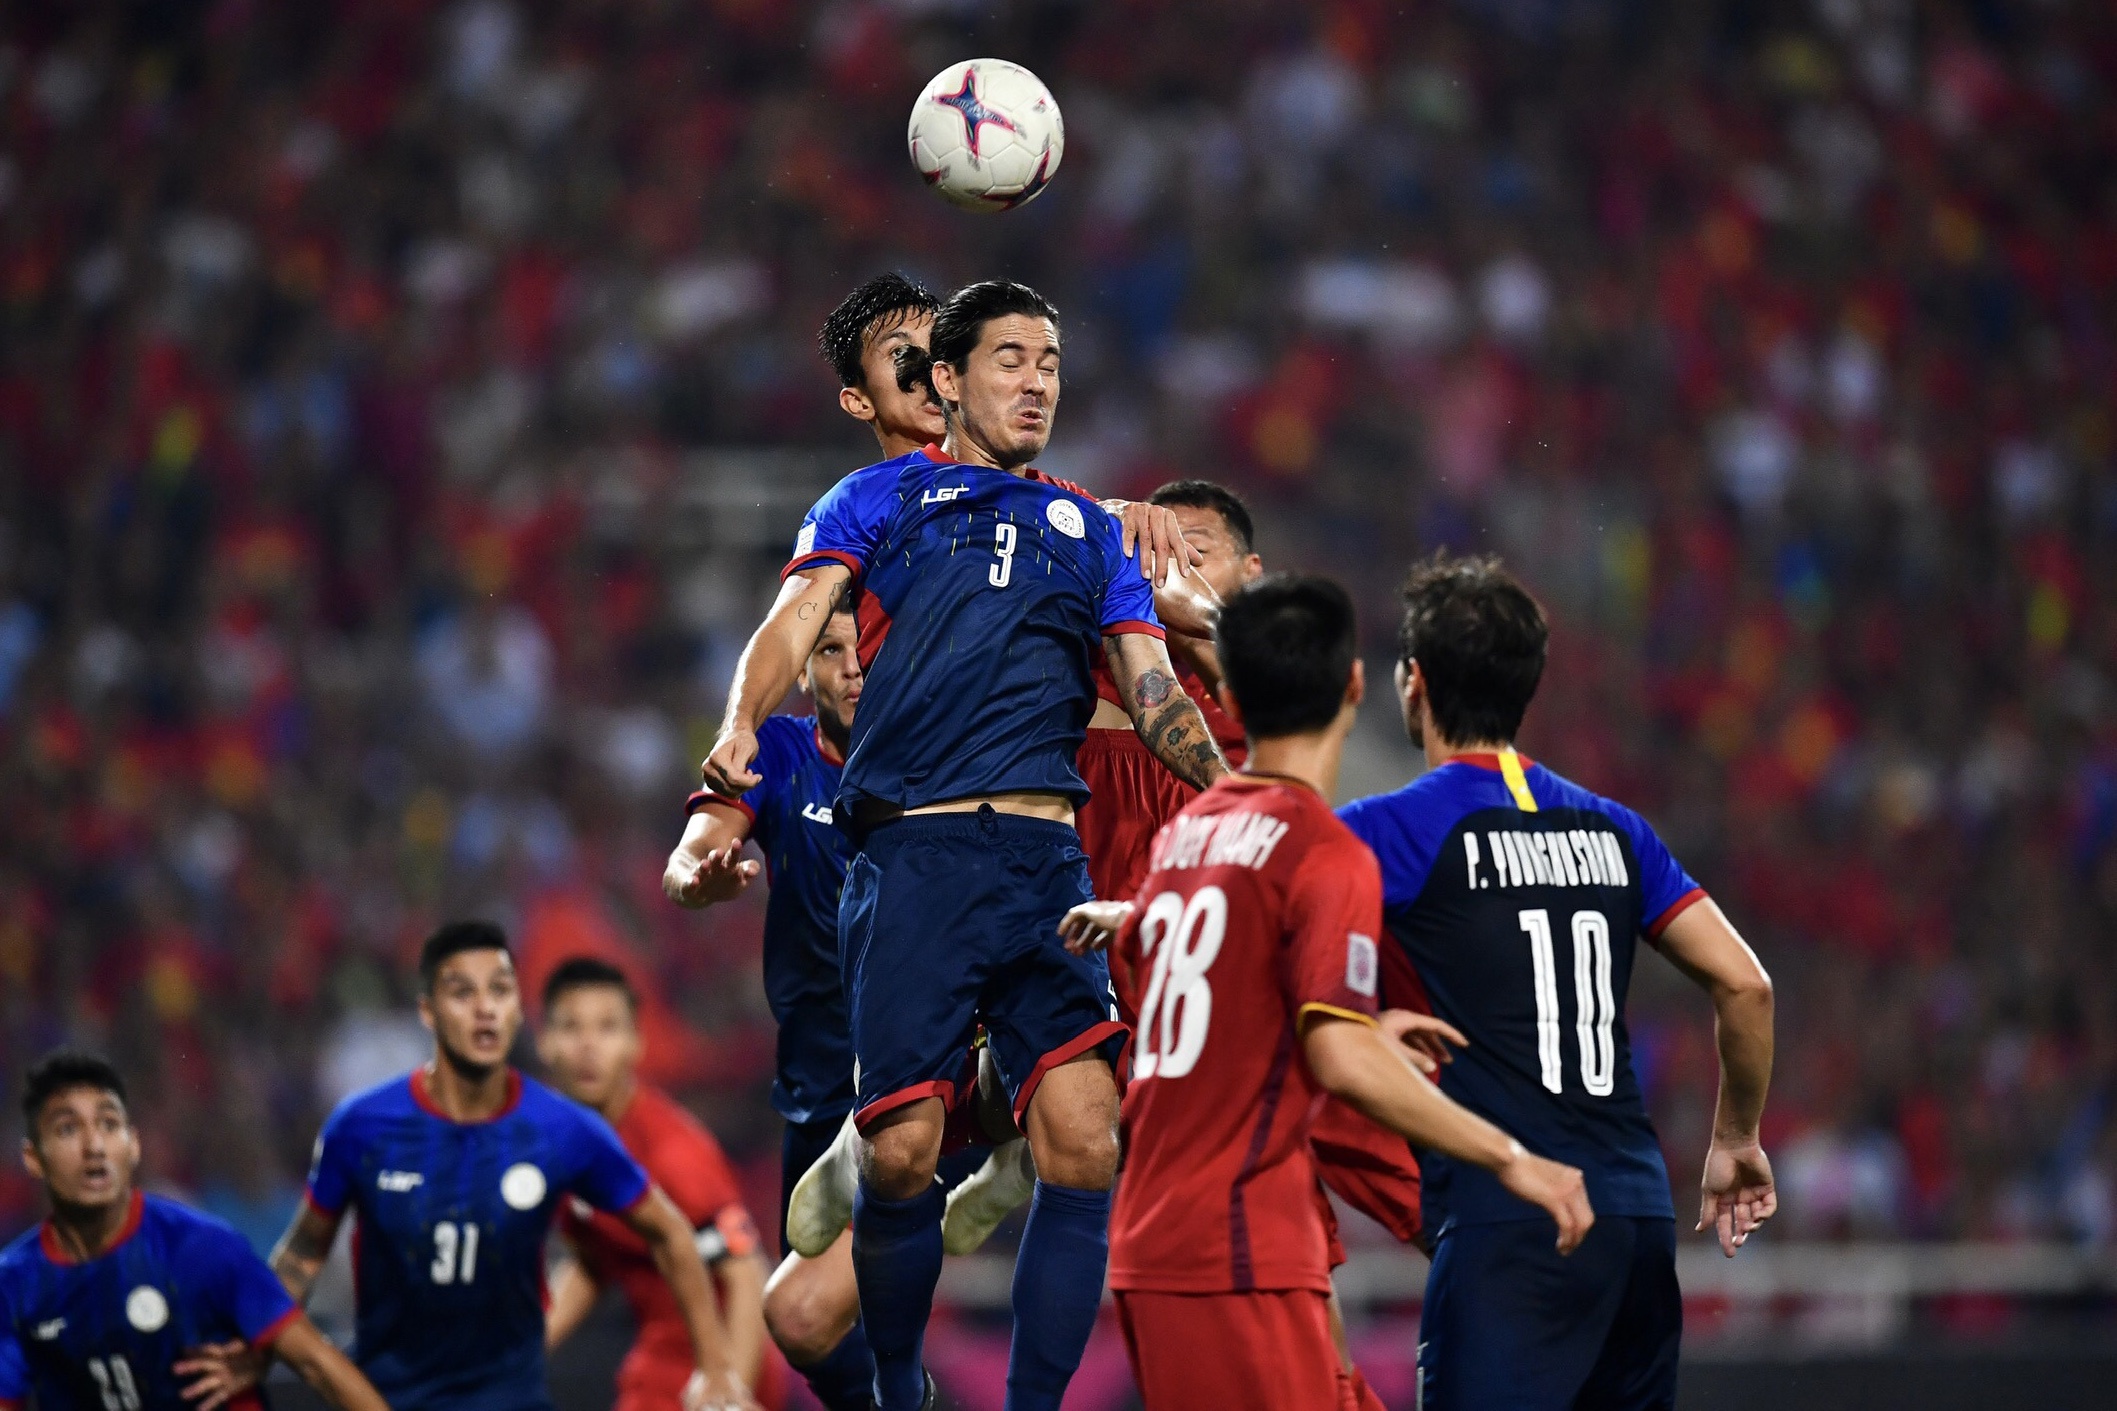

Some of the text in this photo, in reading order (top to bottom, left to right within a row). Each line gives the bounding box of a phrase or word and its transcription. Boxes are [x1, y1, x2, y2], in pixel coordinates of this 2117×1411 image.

[988, 523, 1018, 588] 3
[1463, 831, 1489, 890] P.
[1133, 885, 1228, 1080] 28
[1518, 908, 1616, 1097] 10
[431, 1220, 479, 1285] 31
